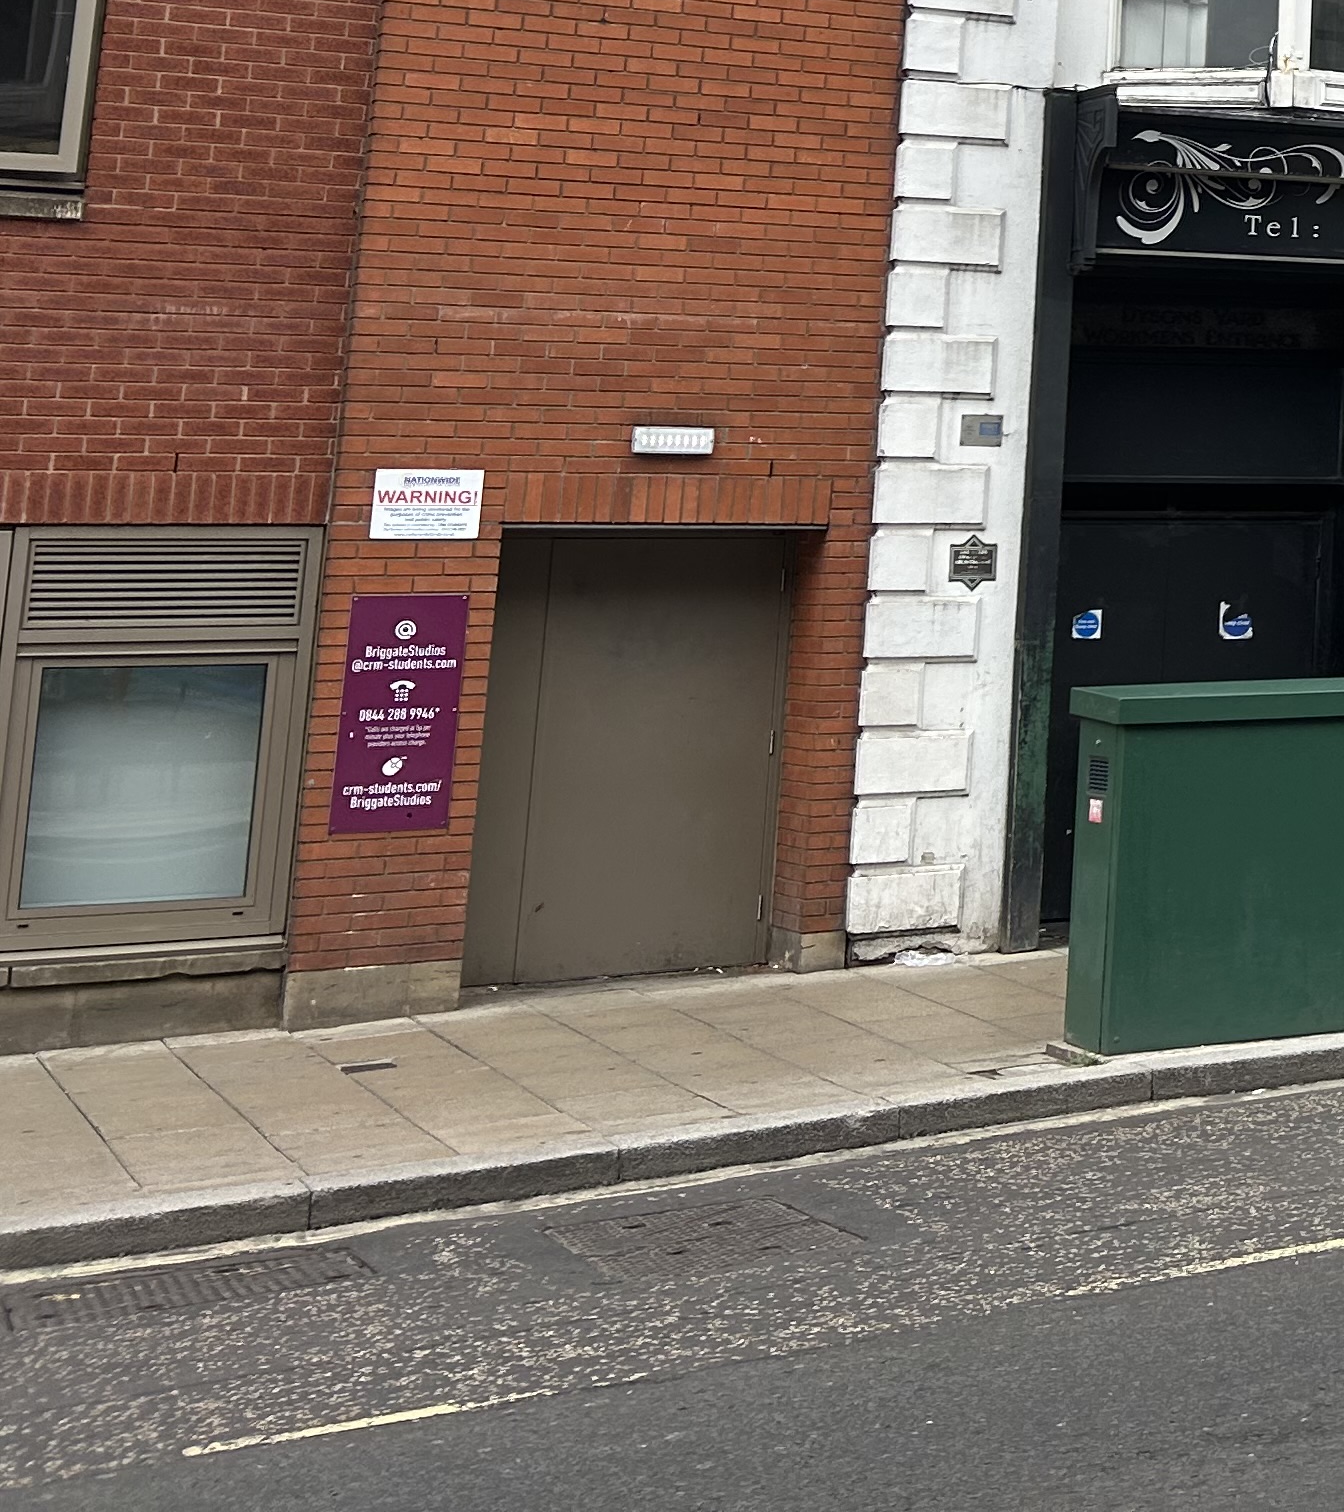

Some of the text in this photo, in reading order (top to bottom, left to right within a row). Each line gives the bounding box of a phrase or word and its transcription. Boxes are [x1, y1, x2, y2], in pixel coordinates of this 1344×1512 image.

[1244, 213, 1324, 240] Tel:
[377, 490, 479, 505] WARNING!
[365, 644, 447, 660] BriggateStudios
[352, 658, 457, 673] @crm-students.com
[359, 708, 386, 722] 0844
[387, 708, 407, 721] 288
[342, 779, 442, 796] crm-students.com/
[350, 794, 432, 811] BriggateStudios
